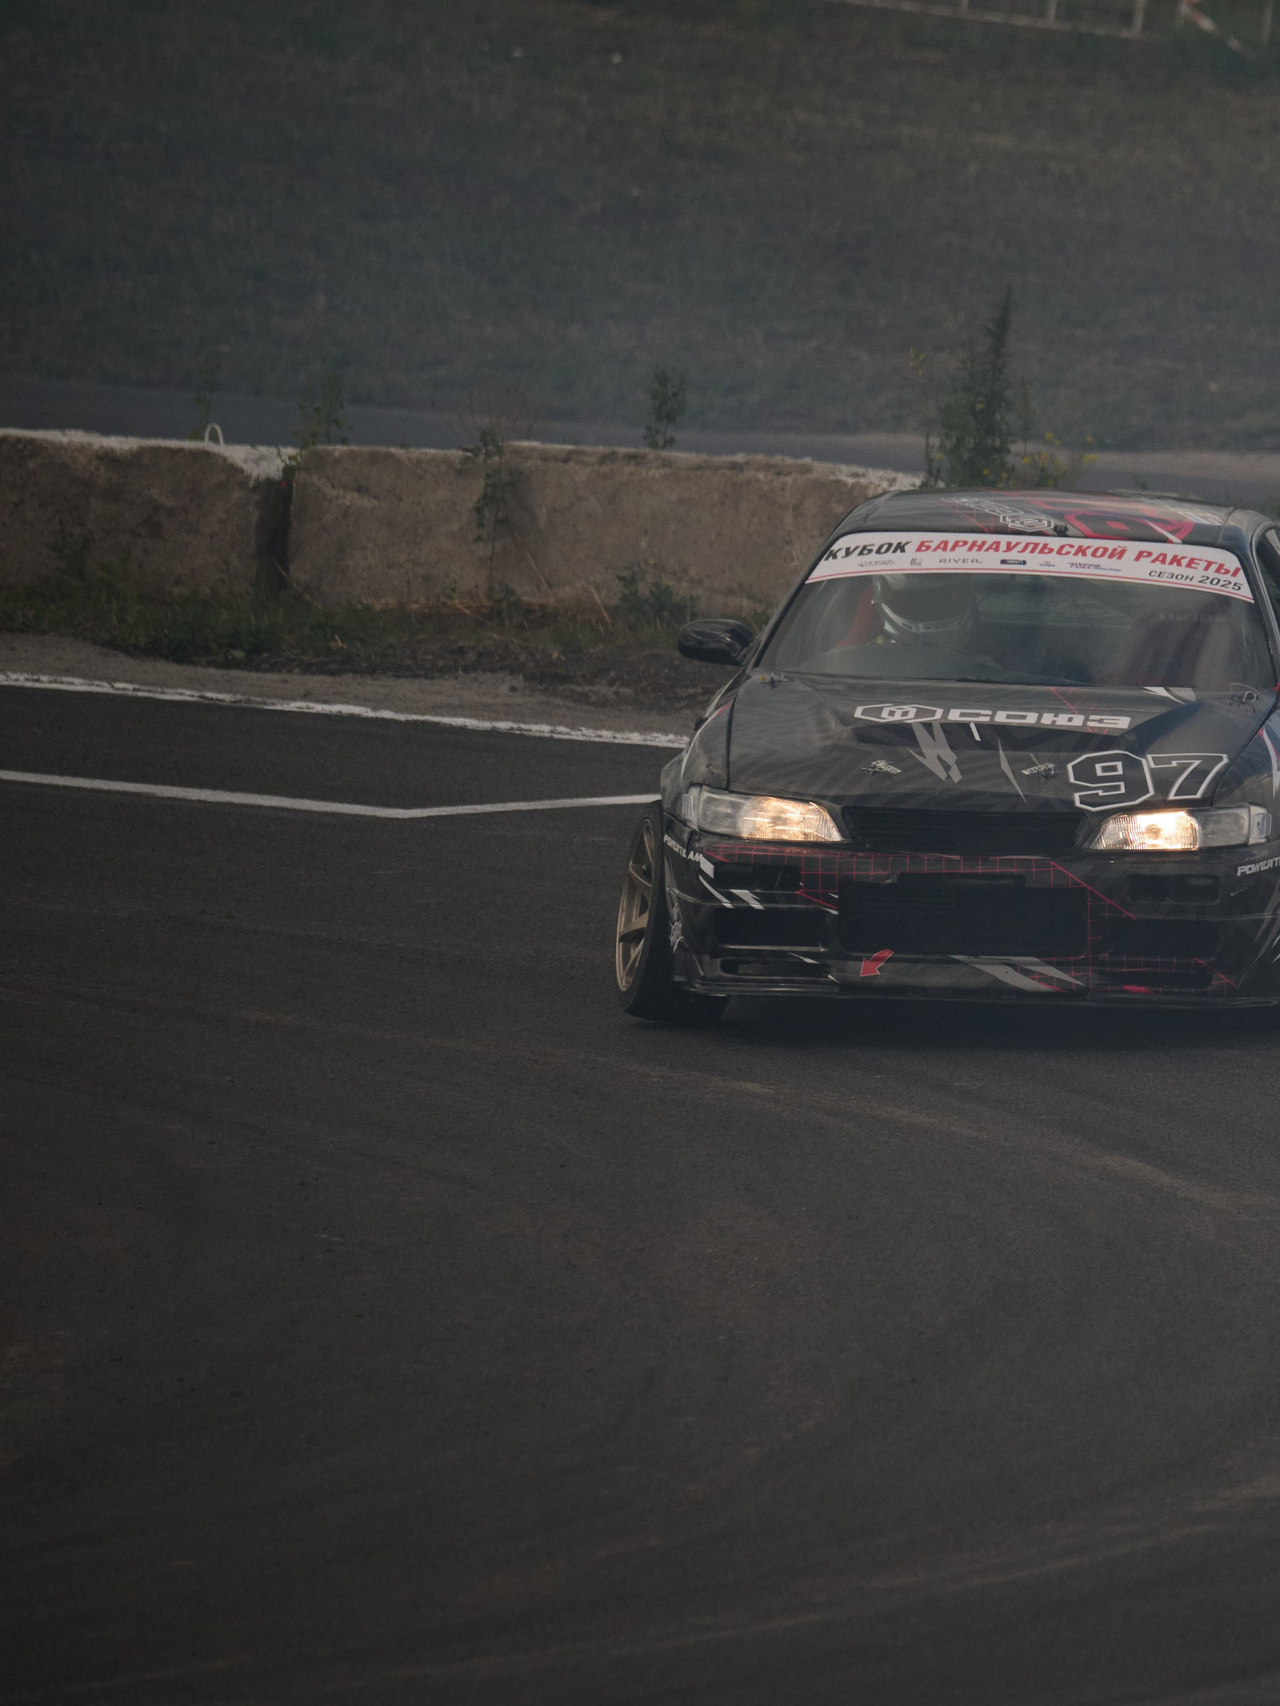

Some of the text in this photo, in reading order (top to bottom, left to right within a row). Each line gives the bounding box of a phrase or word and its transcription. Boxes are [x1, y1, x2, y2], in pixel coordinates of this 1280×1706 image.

[824, 540, 911, 562] КУБОК
[915, 539, 1128, 562] БАРНАУЛЬСКОЙ
[1133, 549, 1243, 578] РАКЕТЫ
[1148, 569, 1245, 592] СЕЗОН 2025
[947, 707, 1132, 730] СОЮЗ
[1066, 749, 1230, 812] 97
